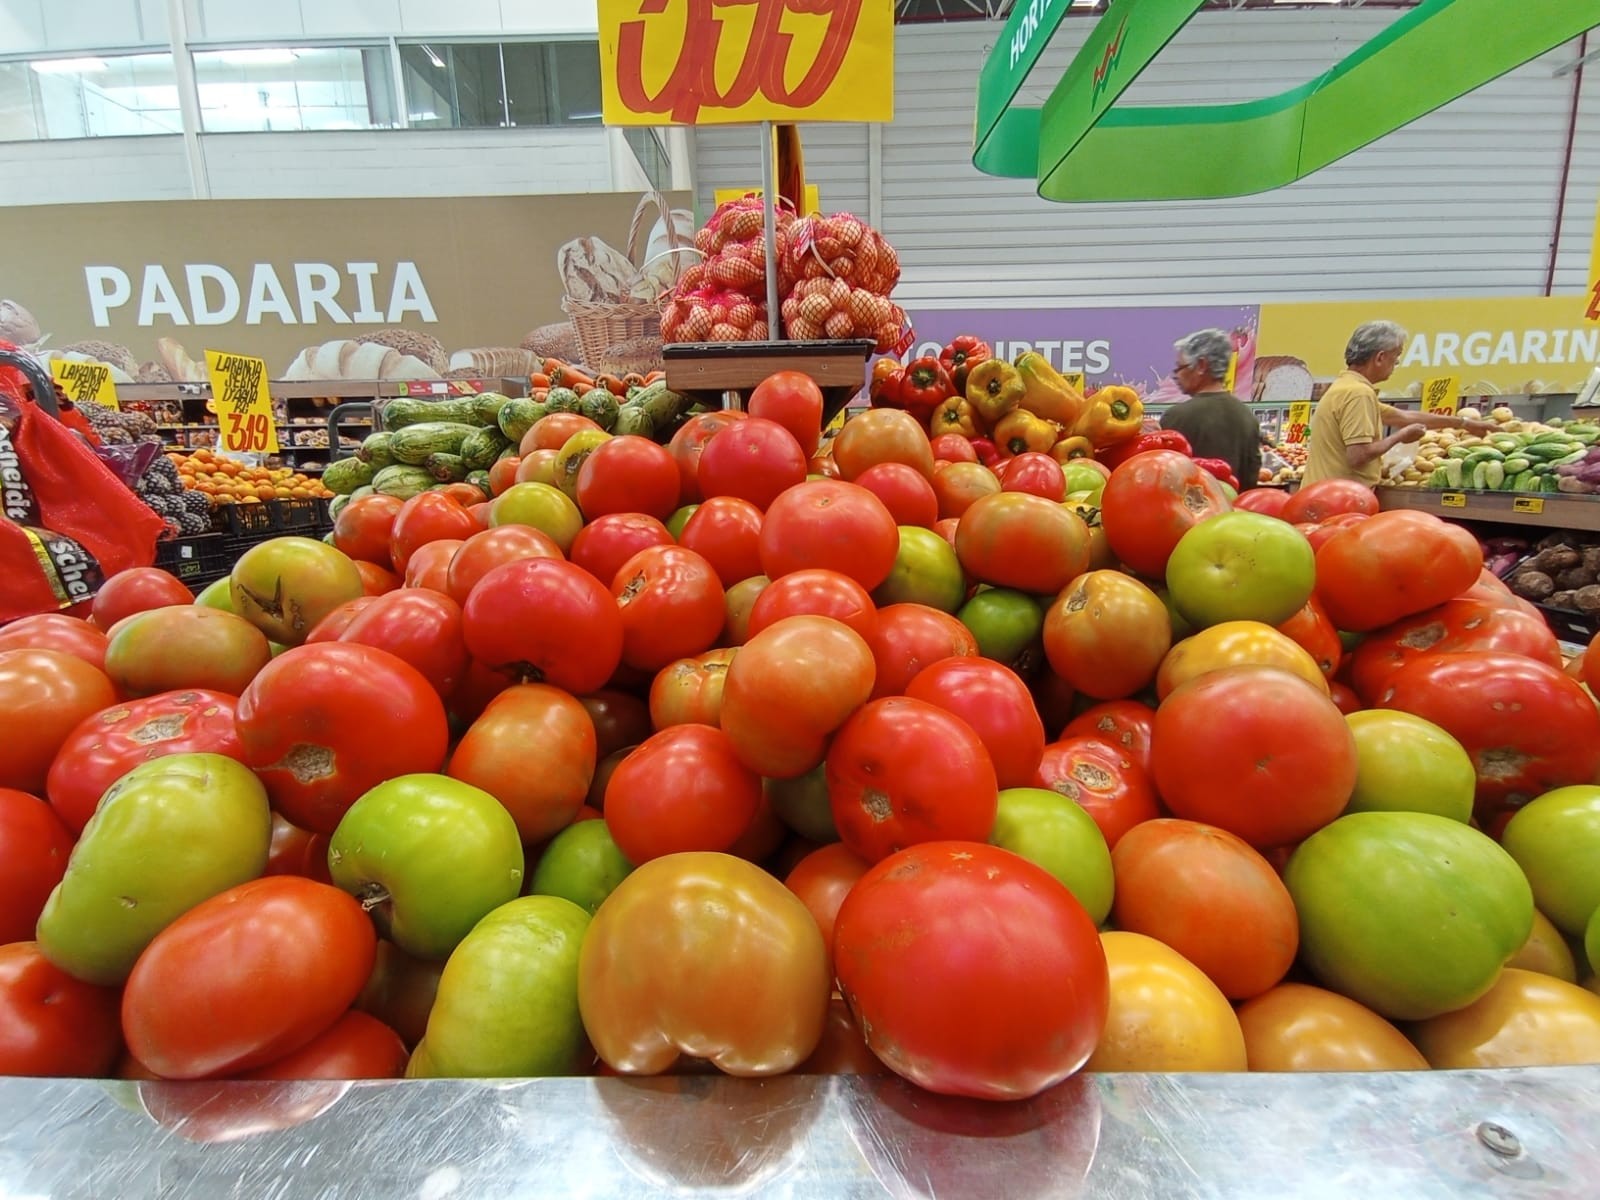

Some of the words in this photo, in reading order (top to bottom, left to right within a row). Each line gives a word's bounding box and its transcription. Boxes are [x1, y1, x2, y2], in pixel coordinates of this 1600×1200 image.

[1009, 0, 1052, 71] HORT
[84, 261, 439, 327] PADARIA
[1401, 329, 1600, 369] ARGARIN
[227, 413, 269, 452] 3,19
